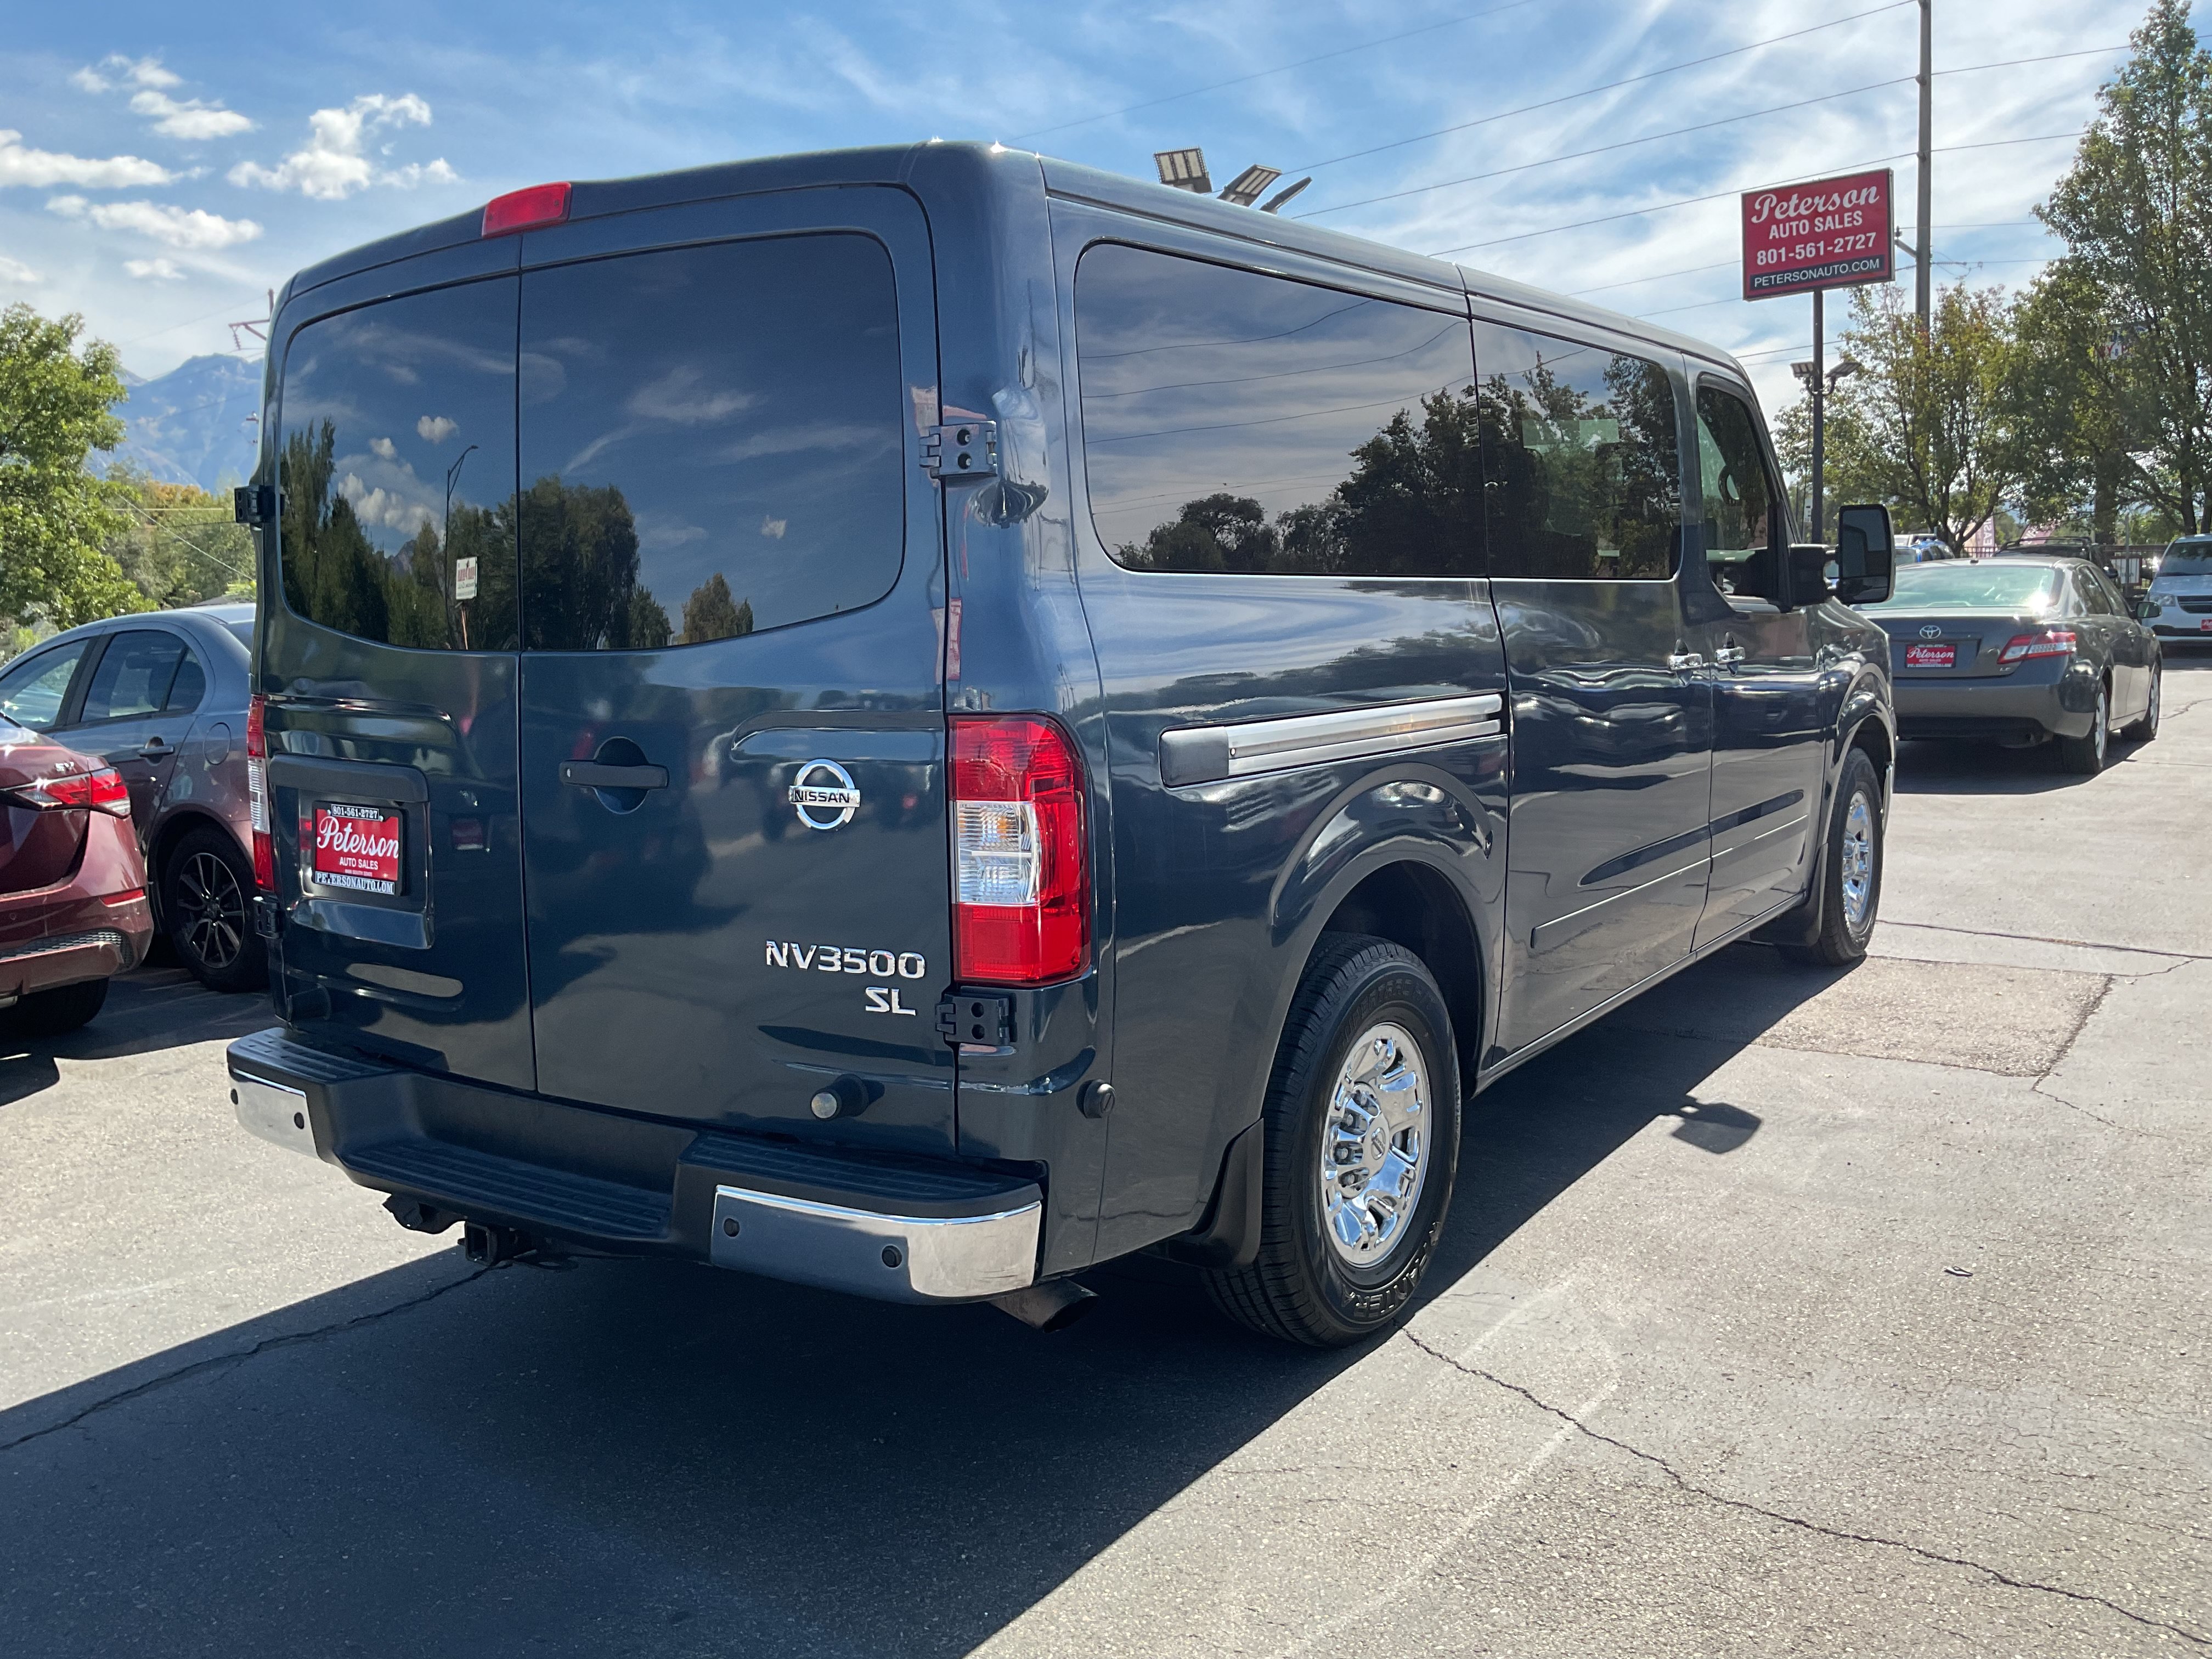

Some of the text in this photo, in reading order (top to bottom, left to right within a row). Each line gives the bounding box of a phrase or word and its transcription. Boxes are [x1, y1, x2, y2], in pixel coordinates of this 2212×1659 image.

[1751, 186, 1880, 224] Peterson
[1769, 210, 1863, 239] AUTO SALES
[1757, 232, 1877, 266] 801-561-2727
[1754, 258, 1880, 287] PETERSONAUTO.COM
[1906, 648, 1954, 658] Peterson
[55, 761, 75, 772] SV
[793, 788, 850, 803] NISSAN
[332, 806, 377, 819] 801-561-2727
[317, 816, 399, 859] Peterson
[339, 856, 379, 870] AUTO SALES
[766, 940, 926, 979] NV3500
[865, 986, 917, 1016] SL
